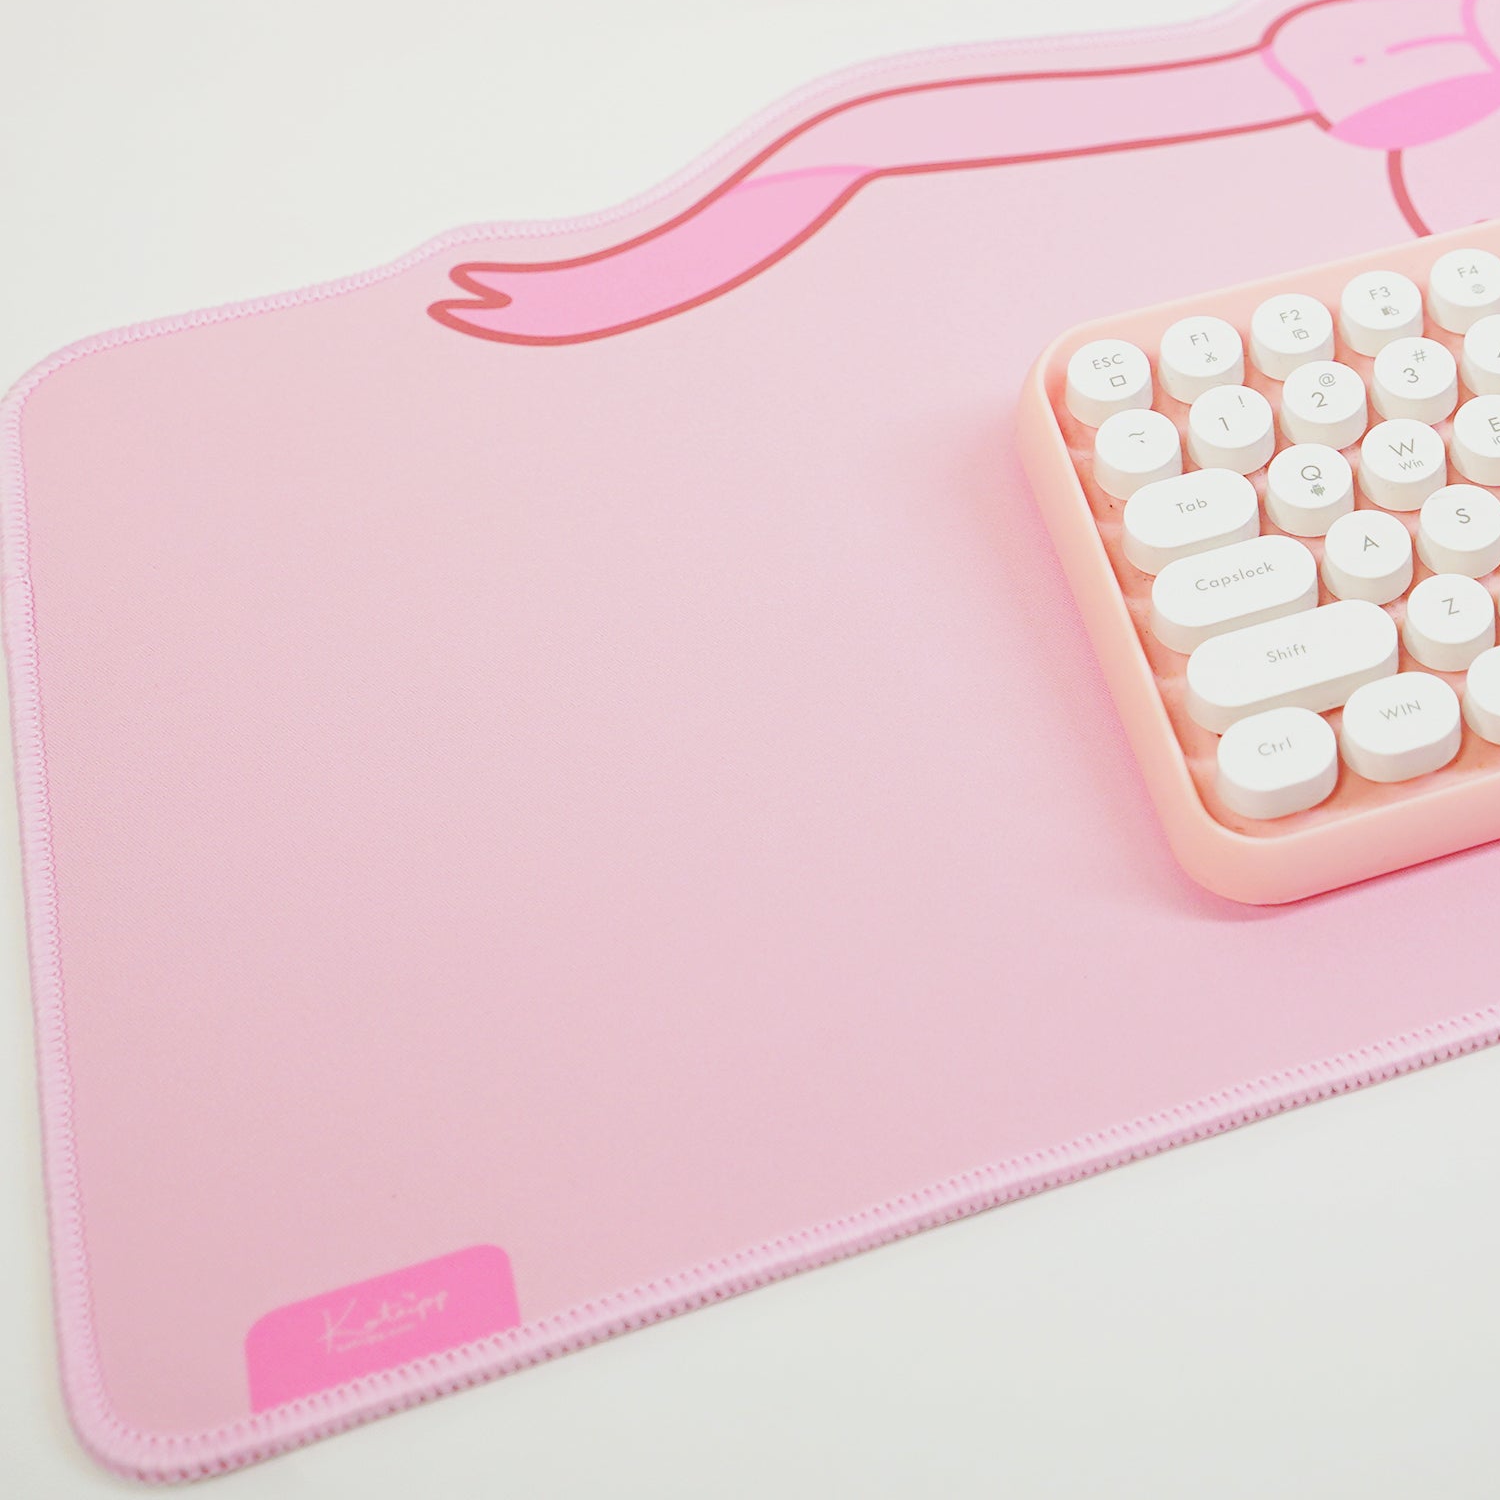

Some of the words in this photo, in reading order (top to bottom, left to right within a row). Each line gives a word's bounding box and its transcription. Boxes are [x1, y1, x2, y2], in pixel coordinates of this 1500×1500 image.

[1456, 264, 1480, 279] F4
[1368, 285, 1392, 301] F3
[1278, 308, 1302, 324] F2
[1189, 331, 1210, 347] F1
[1091, 352, 1125, 371] ESC
[1412, 348, 1427, 364] #
[1317, 372, 1337, 388] @
[1402, 367, 1420, 384] 3
[1237, 394, 1246, 409] !
[1310, 391, 1329, 409] 2
[1218, 416, 1230, 432] 1
[1387, 437, 1415, 458] W
[1299, 464, 1323, 482] Q
[1397, 458, 1425, 471] Win
[1175, 497, 1209, 514] Tab
[1455, 507, 1472, 525] S
[1363, 534, 1380, 552] A
[1194, 561, 1275, 592] Capslock
[1441, 596, 1461, 616] Z
[1265, 643, 1307, 664] Shift
[1378, 699, 1422, 721] WIN
[1257, 736, 1293, 757] Ctrl
